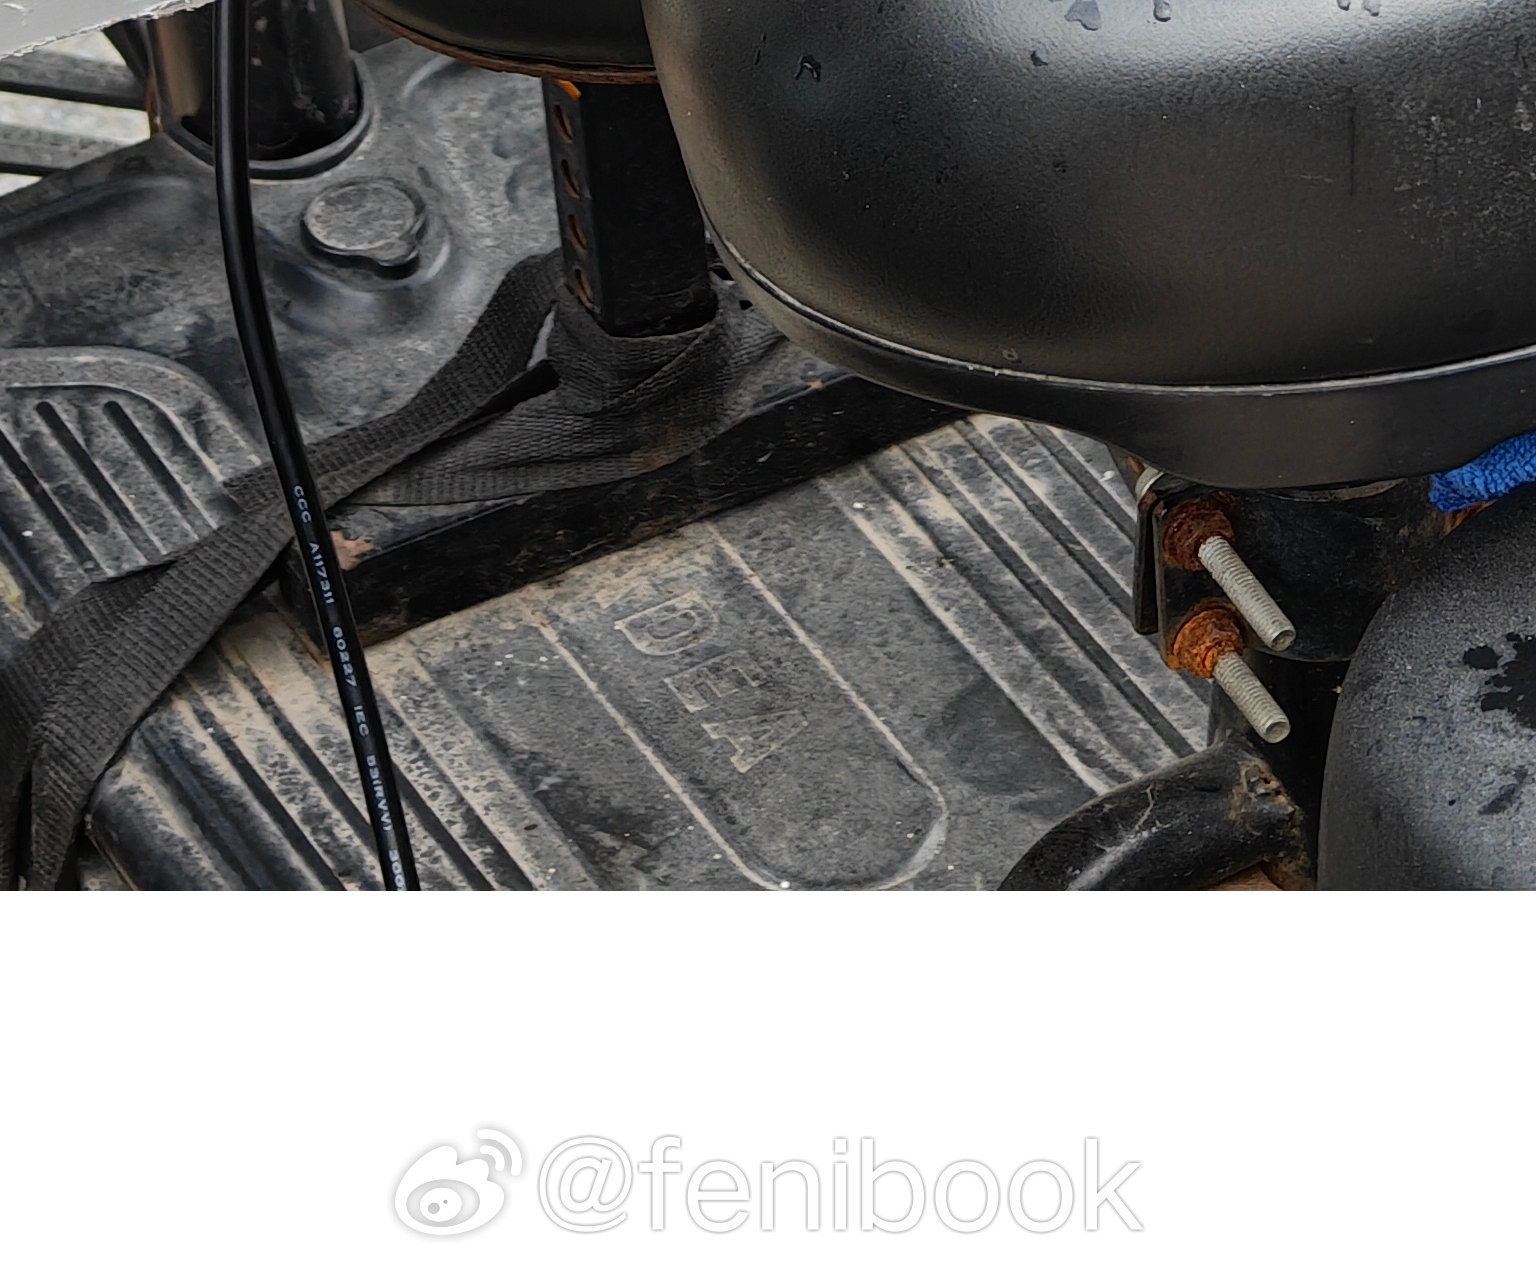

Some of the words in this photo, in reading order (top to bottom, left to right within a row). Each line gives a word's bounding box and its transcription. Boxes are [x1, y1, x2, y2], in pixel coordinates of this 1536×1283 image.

[293, 485, 312, 524] CCC
[308, 541, 336, 605] A117311
[332, 625, 358, 688] 60227
[353, 704, 370, 737] IEC
[366, 754, 393, 832] 53(RVV)
[388, 848, 407, 891] 300
